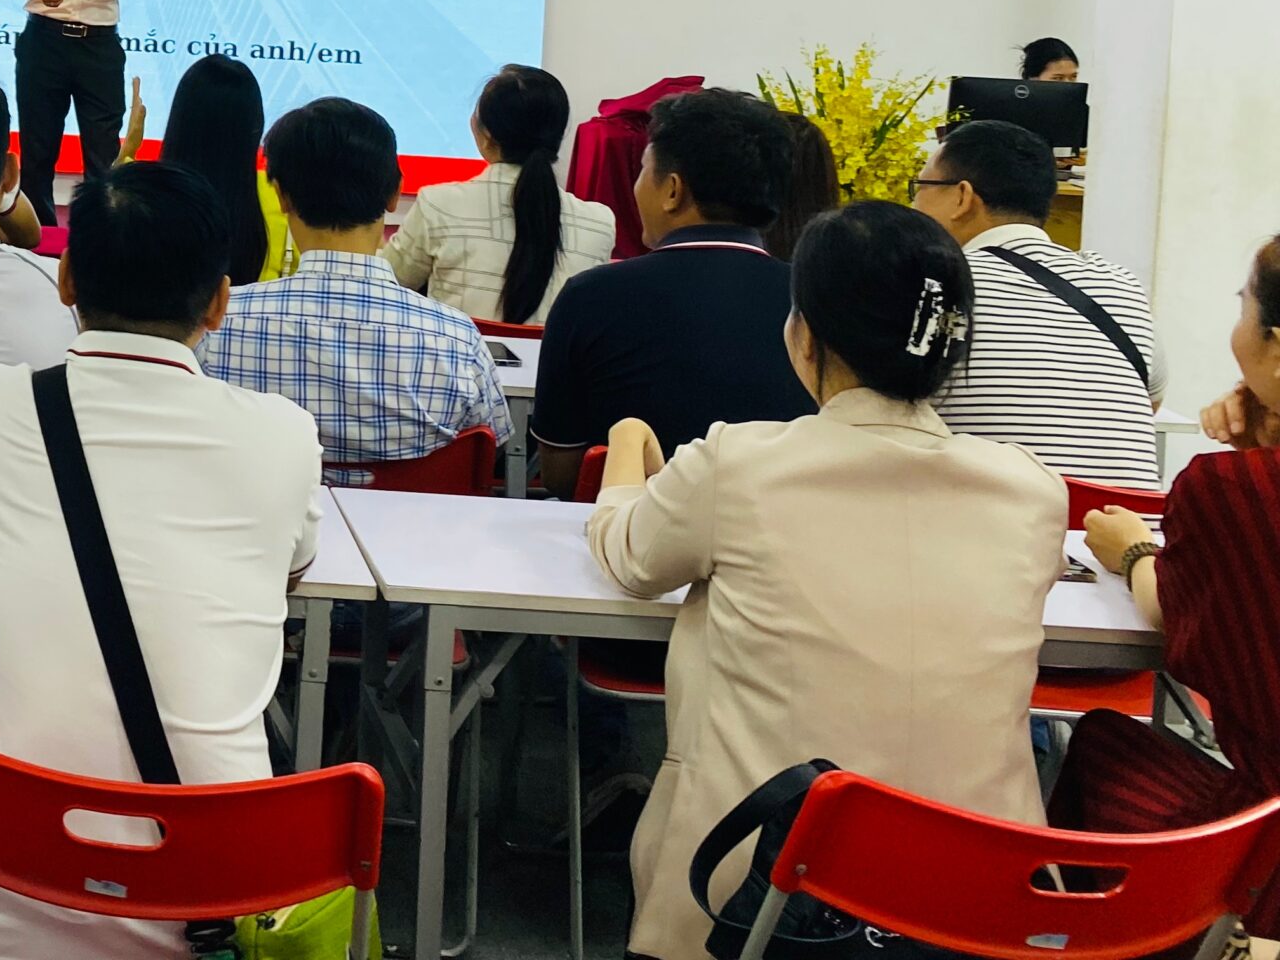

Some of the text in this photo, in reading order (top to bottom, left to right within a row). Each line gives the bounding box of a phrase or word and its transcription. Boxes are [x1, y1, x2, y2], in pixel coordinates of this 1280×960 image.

[120, 29, 176, 54] mắc
[187, 33, 239, 58] của
[250, 40, 363, 64] anh/em
